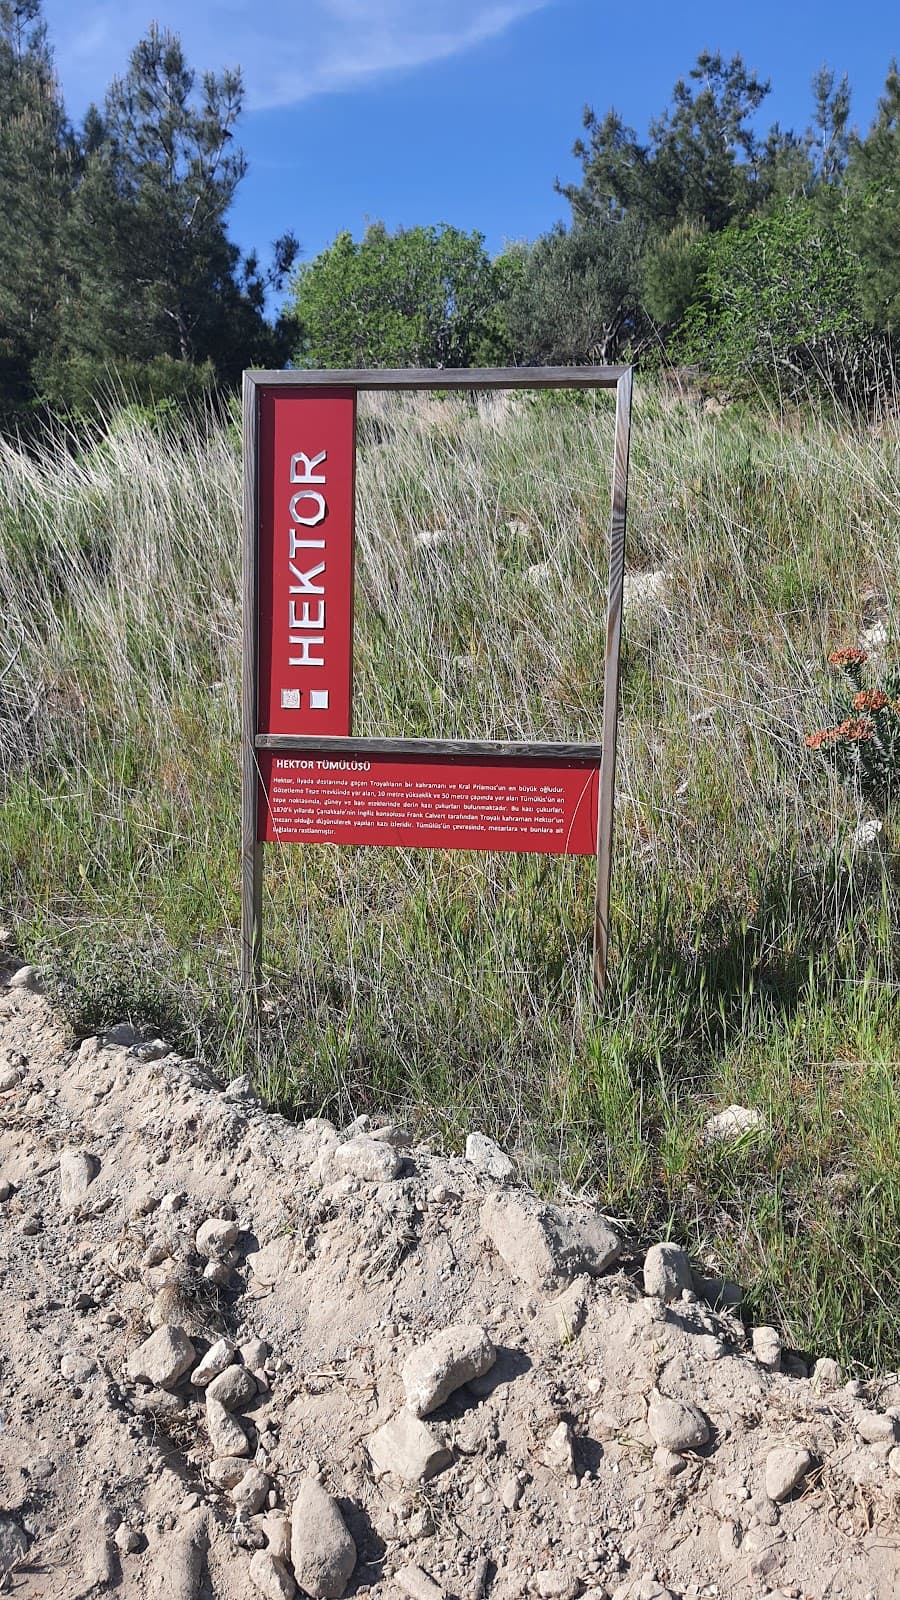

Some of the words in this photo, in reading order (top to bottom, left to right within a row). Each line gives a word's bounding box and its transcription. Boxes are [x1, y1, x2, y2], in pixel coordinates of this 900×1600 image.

[288, 449, 327, 666] HEKTOR
[276, 759, 315, 769] HEKTOR
[317, 759, 371, 771] TÜMÜLÜSÜ
[273, 786, 304, 794] Gözetleme
[306, 787, 320, 796] Tepe
[459, 782, 470, 790] Kral
[273, 796, 286, 805] tepe
